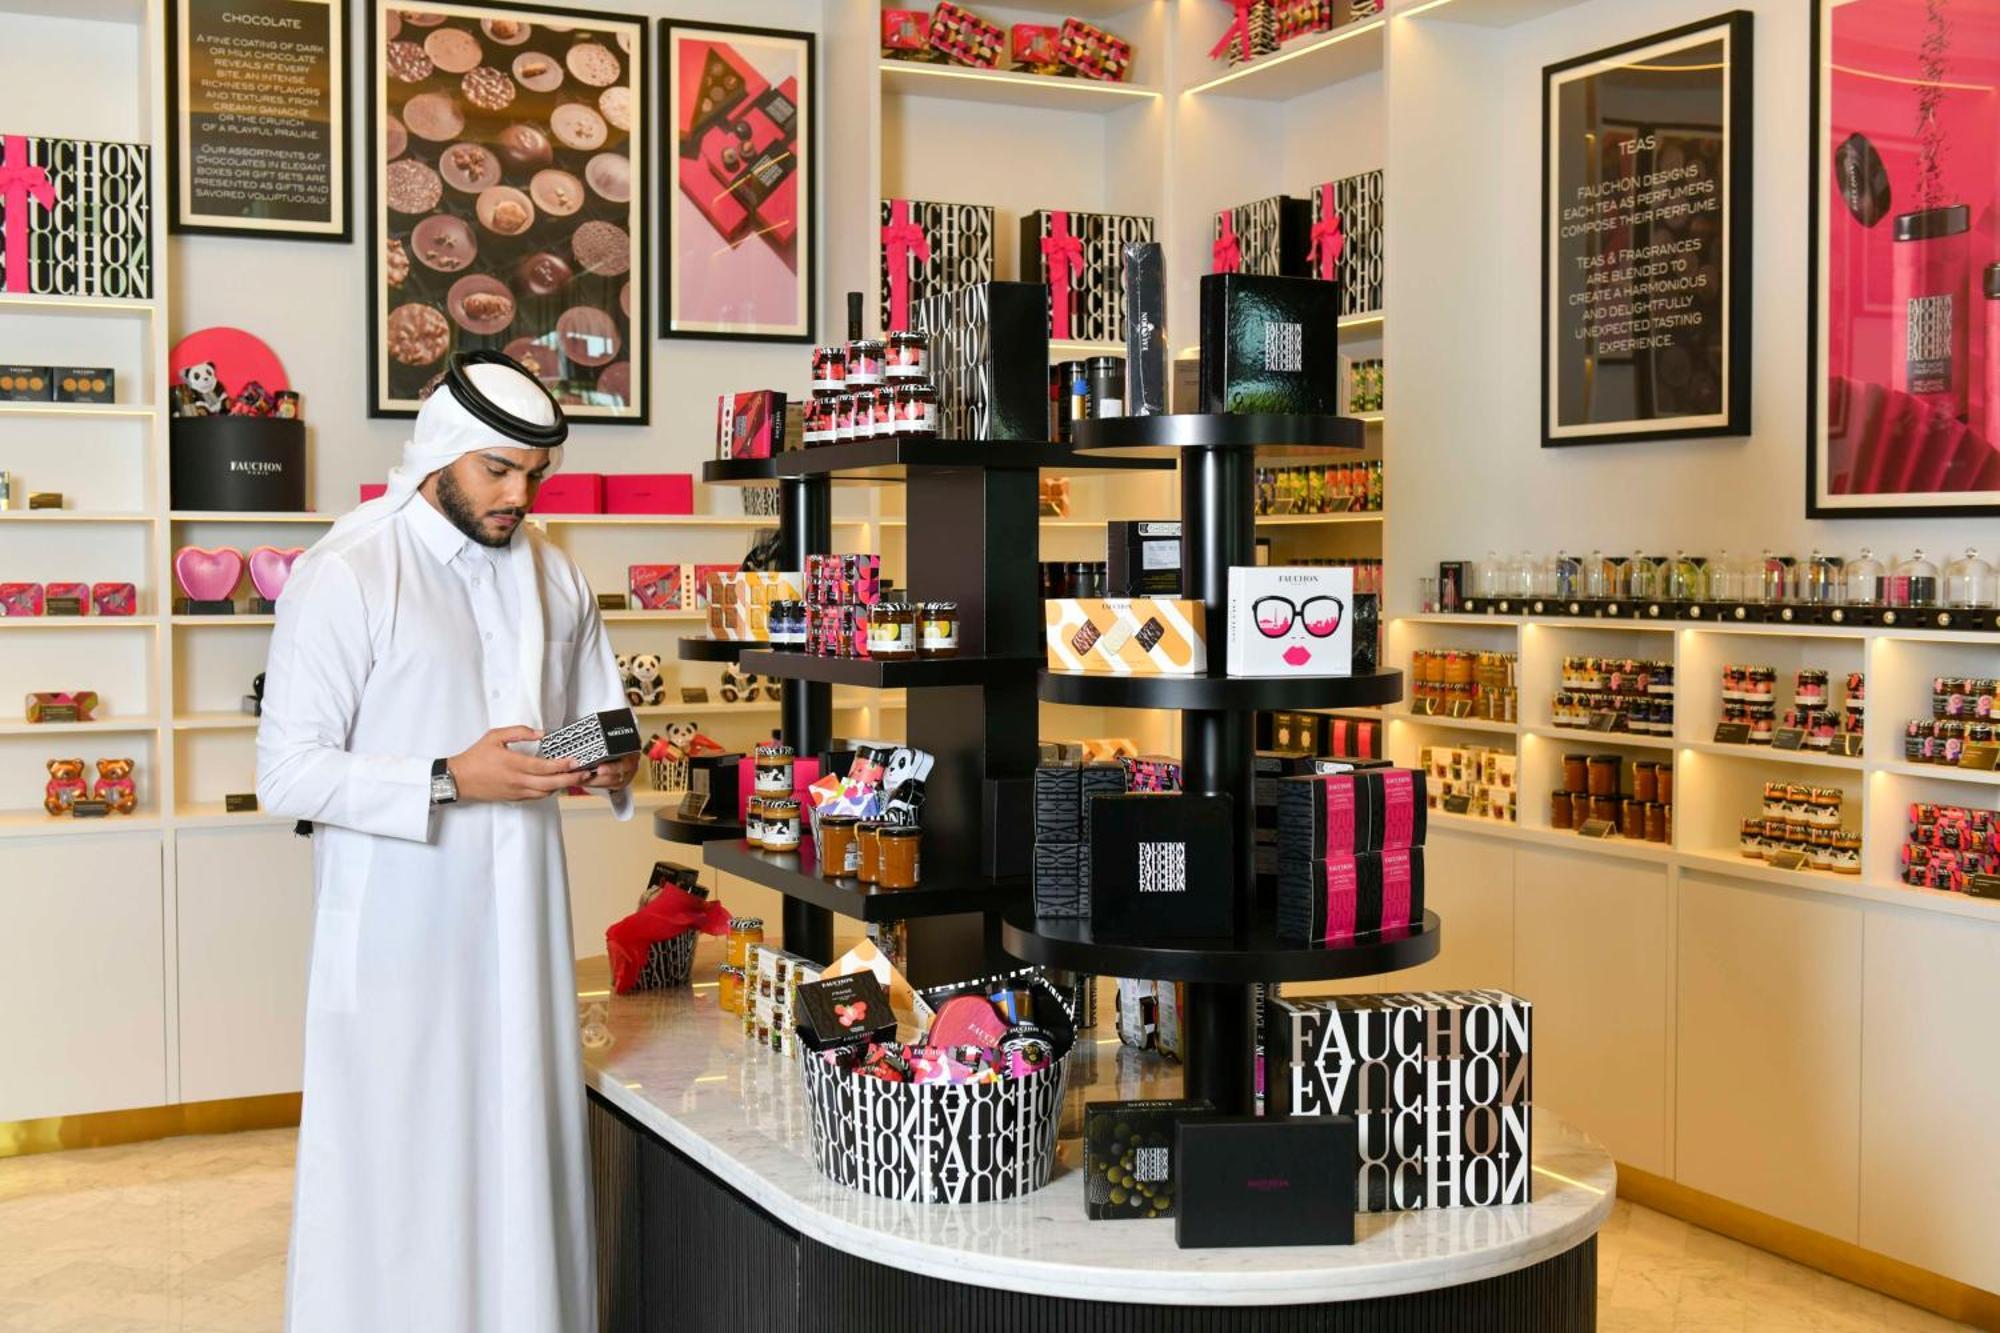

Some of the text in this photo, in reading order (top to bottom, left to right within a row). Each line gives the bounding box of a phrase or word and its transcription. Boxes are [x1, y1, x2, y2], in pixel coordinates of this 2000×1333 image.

[222, 12, 302, 29] CHOCOLATE
[196, 33, 324, 53] A FINE COATING OF DARK
[209, 47, 316, 64] OR MILK CHOCOLATE
[214, 58, 310, 73] REVEALS AT EVERY
[244, 72, 260, 80] AN
[261, 73, 306, 84] INTENSE
[201, 79, 320, 96] RICHNESS OF FLAVORS
[205, 91, 229, 99] AND
[288, 97, 319, 107] FROM
[212, 102, 310, 117] CREAMY GANACHE
[218, 113, 305, 126] OR THE CRUNCH
[202, 123, 217, 131] OF
[227, 125, 273, 136] PLAYFUL
[228, 147, 306, 160] ASSORTMENTS
[307, 152, 321, 160] OF
[1618, 135, 1656, 155] TEAS
[28, 138, 148, 179] UCHON
[196, 155, 266, 168] CHOCOLATES
[281, 161, 327, 172] ELEGANT
[196, 167, 327, 183] BOXES OR GIFT SETS ARE
[1577, 164, 1699, 200] FAUCHON DESIGNS
[194, 177, 328, 194] PRESENTED AS GIFTS AND
[196, 188, 245, 199] SAVORED
[1564, 179, 1715, 220] EACH TEA AS PERFUMERS
[1561, 217, 1617, 238] COMPOSE
[1619, 211, 1654, 226] THEIR
[1576, 238, 1702, 269] TEAS & FRAGRANCES
[1587, 259, 1688, 284] ARE BLENDED TO
[1569, 274, 1708, 305] CREATE A HARMONIOUS
[1583, 295, 1694, 320] AND DELIGHTFULLY
[1575, 312, 1703, 339] UNEXPECTED TASTING
[1599, 334, 1676, 354] EXPERIENCE.
[231, 461, 282, 471] FAUCHON
[1139, 842, 1185, 852] FAUCHON
[1139, 861, 1185, 872] FAUCHON
[1139, 881, 1185, 891] FAUCHON
[1290, 1002, 1532, 1067] FAUCHON
[1357, 1104, 1529, 1162] UCHON
